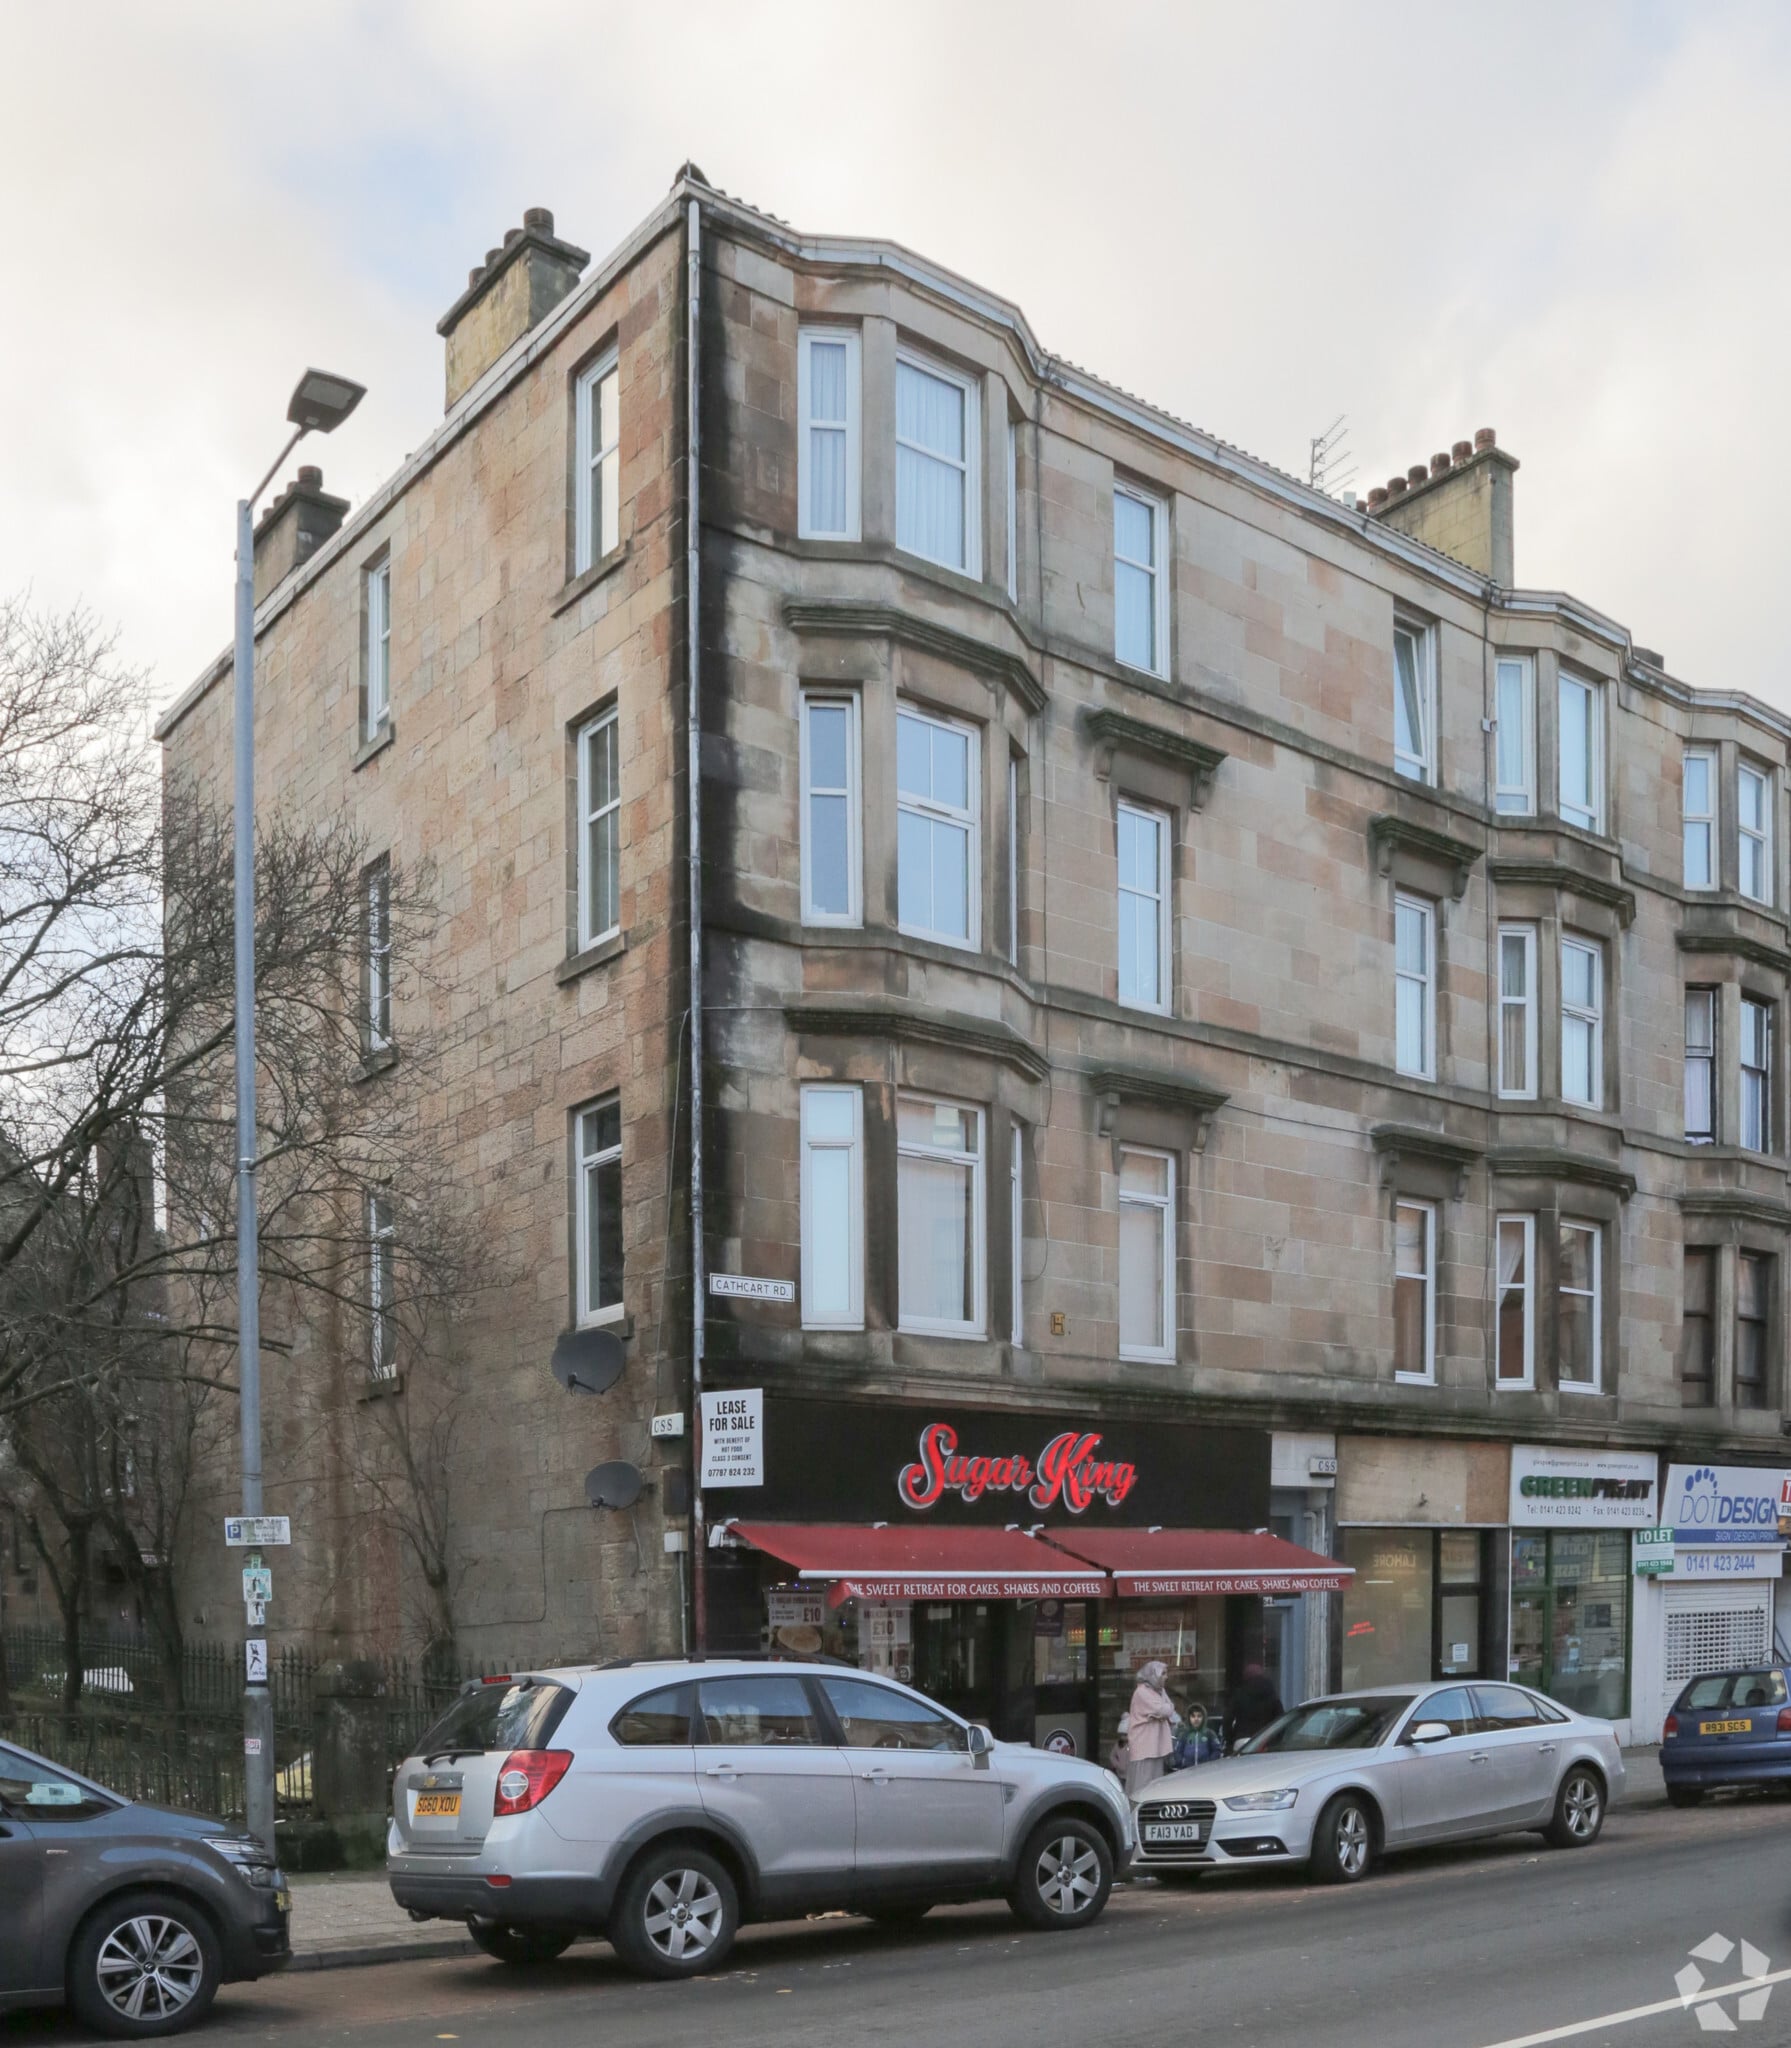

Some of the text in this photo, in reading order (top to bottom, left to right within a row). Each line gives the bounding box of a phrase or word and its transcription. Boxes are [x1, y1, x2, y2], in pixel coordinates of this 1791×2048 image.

[715, 1280, 789, 1297] CATHCART RD.
[717, 1400, 747, 1414] LEASE
[654, 1418, 673, 1433] CSS
[709, 1416, 755, 1431] FOR SALE
[743, 1468, 755, 1476] 232
[898, 1423, 1138, 1514] Sugar King
[1318, 1460, 1336, 1472] CSS
[1539, 1505, 1554, 1514] 0141
[1555, 1505, 1566, 1515] 423
[1606, 1507, 1620, 1516] 0141
[1638, 1529, 1673, 1543] TO LET
[1714, 1531, 1731, 1541] SIGN
[1733, 1531, 1757, 1541] DESIGN
[1686, 1555, 1755, 1572] 0141 423 2444
[866, 1583, 901, 1596] SWEET
[903, 1583, 945, 1596] RETREAT
[947, 1583, 968, 1595] FOR
[969, 1583, 1001, 1597] CAKES,
[1003, 1582, 1039, 1595] SHAKES
[1041, 1582, 1061, 1594] AND
[1063, 1582, 1100, 1594] COFFEES
[1133, 1578, 1340, 1592] THE SWEET RETREAT FOR CAKES, SHAKES AND COFFEES
[803, 1607, 821, 1622] £10
[872, 1619, 894, 1635] £10
[439, 1796, 458, 1812] XDU
[1151, 1825, 1193, 1839] FA13 YAD
